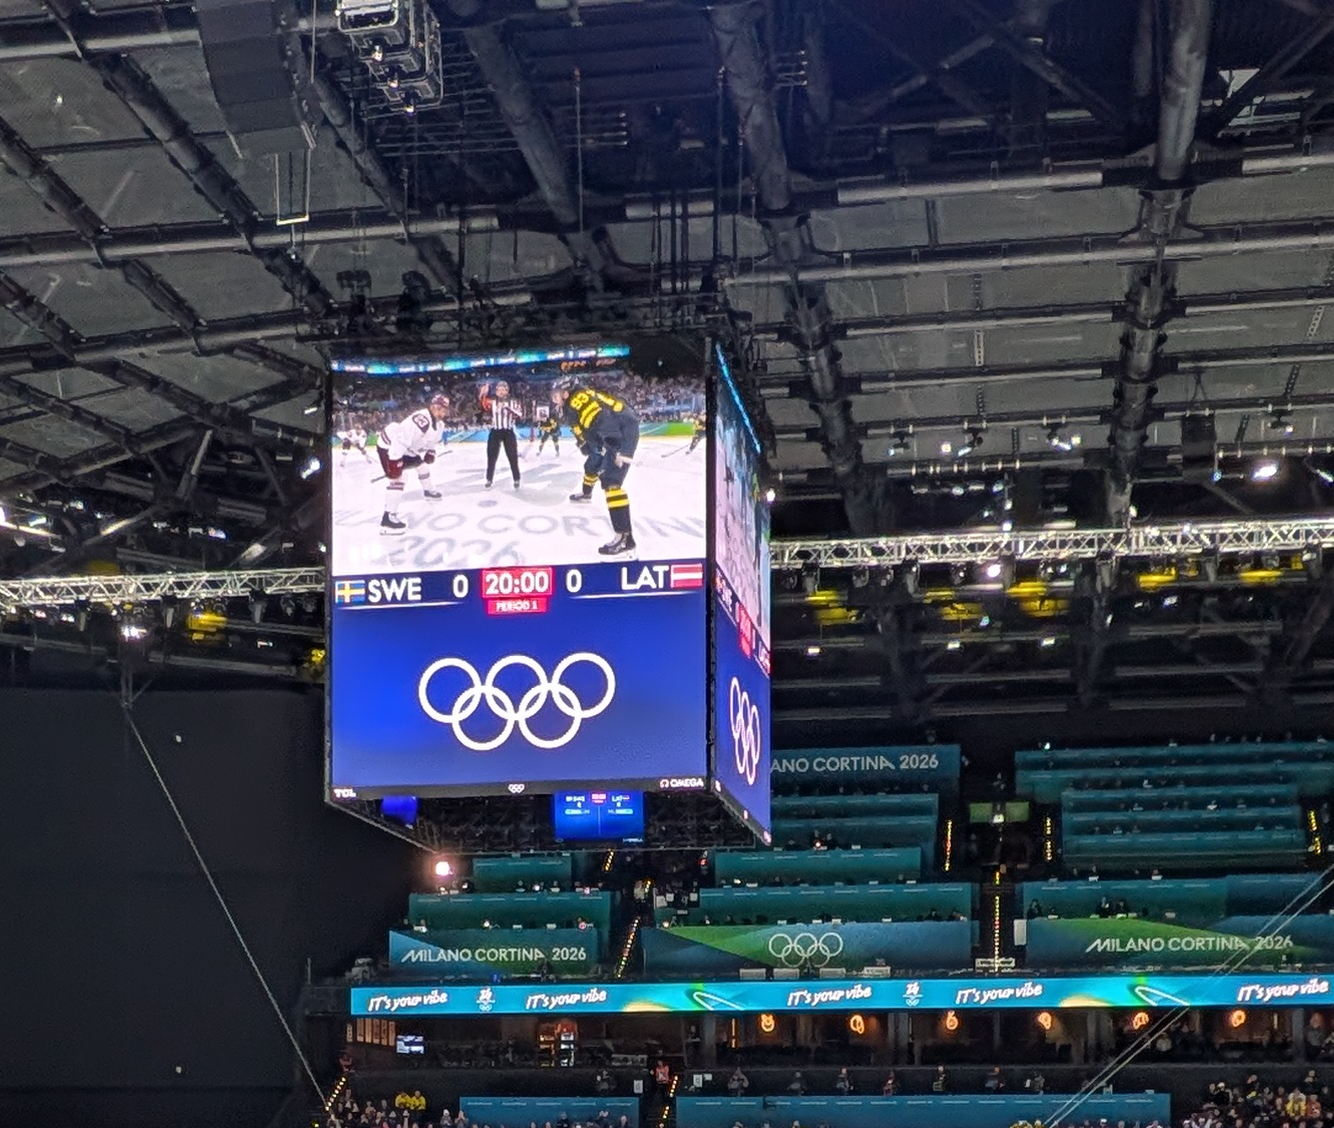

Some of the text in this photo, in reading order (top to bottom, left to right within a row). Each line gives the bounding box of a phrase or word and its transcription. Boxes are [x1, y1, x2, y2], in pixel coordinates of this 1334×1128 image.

[368, 565, 669, 603] SWE 0 20:00 0 LAT
[770, 754, 939, 773] ANO CORTINA 2026
[670, 778, 704, 788] OMEGA
[401, 947, 587, 963] MILANO CORTINA 2026
[1085, 935, 1294, 953] MILANO CORTINA 2026
[391, 993, 422, 1011] your
[423, 987, 448, 1004] vibe
[549, 992, 581, 1009] your
[582, 987, 607, 1003] vibe
[812, 987, 844, 1006] your
[845, 983, 872, 1000] vibe
[980, 987, 1014, 1005] your
[1015, 981, 1043, 998] vibe
[1265, 982, 1299, 1002] your
[1300, 977, 1329, 995] vibe
